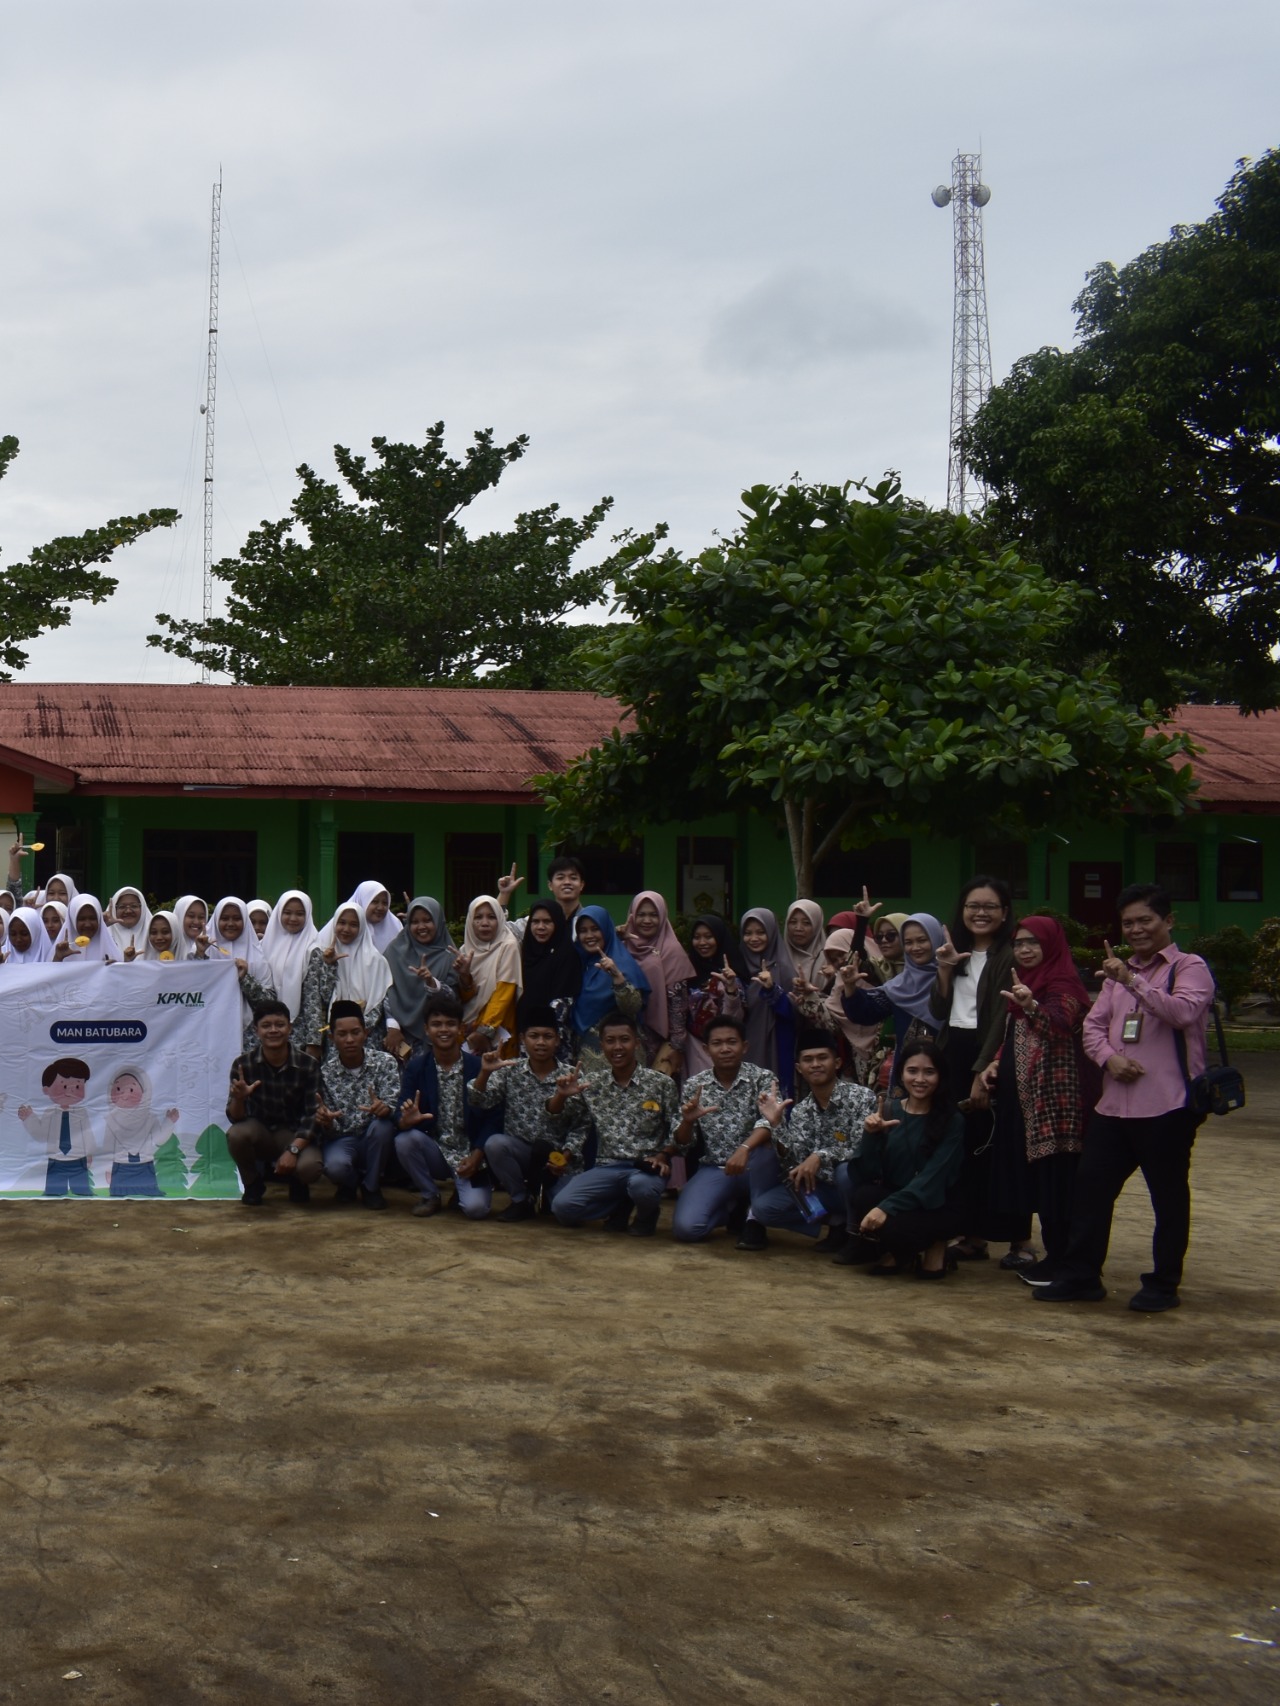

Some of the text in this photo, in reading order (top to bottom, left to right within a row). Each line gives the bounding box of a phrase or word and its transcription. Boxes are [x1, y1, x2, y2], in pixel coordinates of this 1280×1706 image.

[156, 992, 205, 1004] KPKNL
[56, 1027, 142, 1037] MAN BATUBARA
